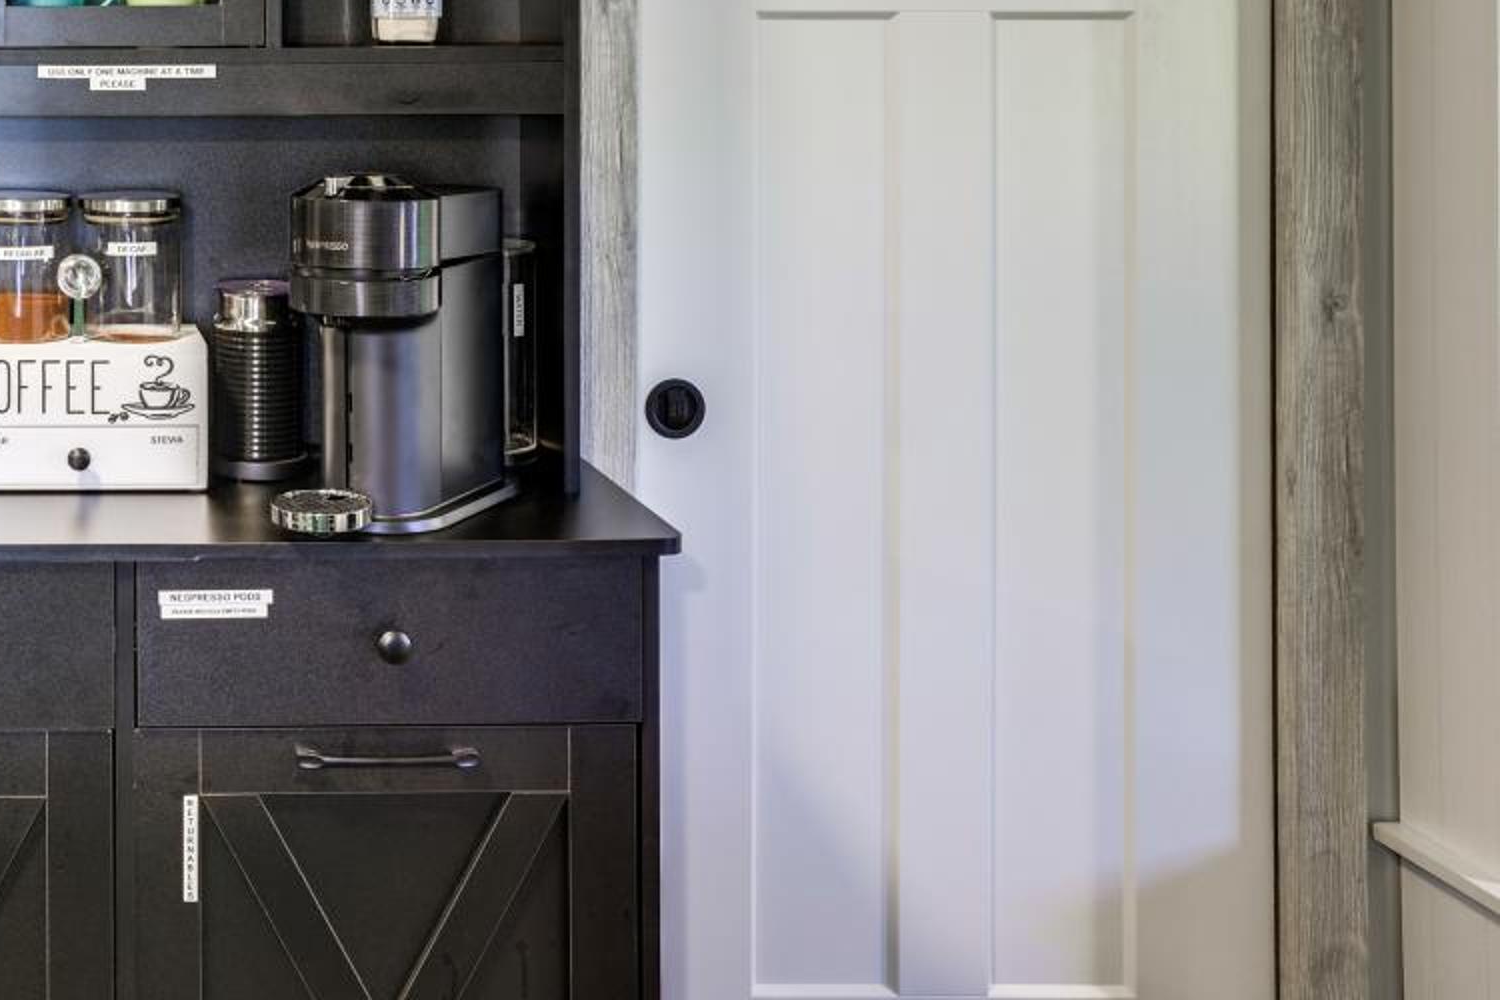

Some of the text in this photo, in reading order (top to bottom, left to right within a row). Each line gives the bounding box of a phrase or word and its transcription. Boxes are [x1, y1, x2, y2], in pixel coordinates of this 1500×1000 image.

[67, 67, 92, 76] ONLY
[95, 67, 116, 76] ONE
[117, 67, 156, 75] MACHINE
[99, 79, 135, 88] PLEASE
[150, 435, 184, 444] STEVIA
[233, 592, 261, 601] PODS
